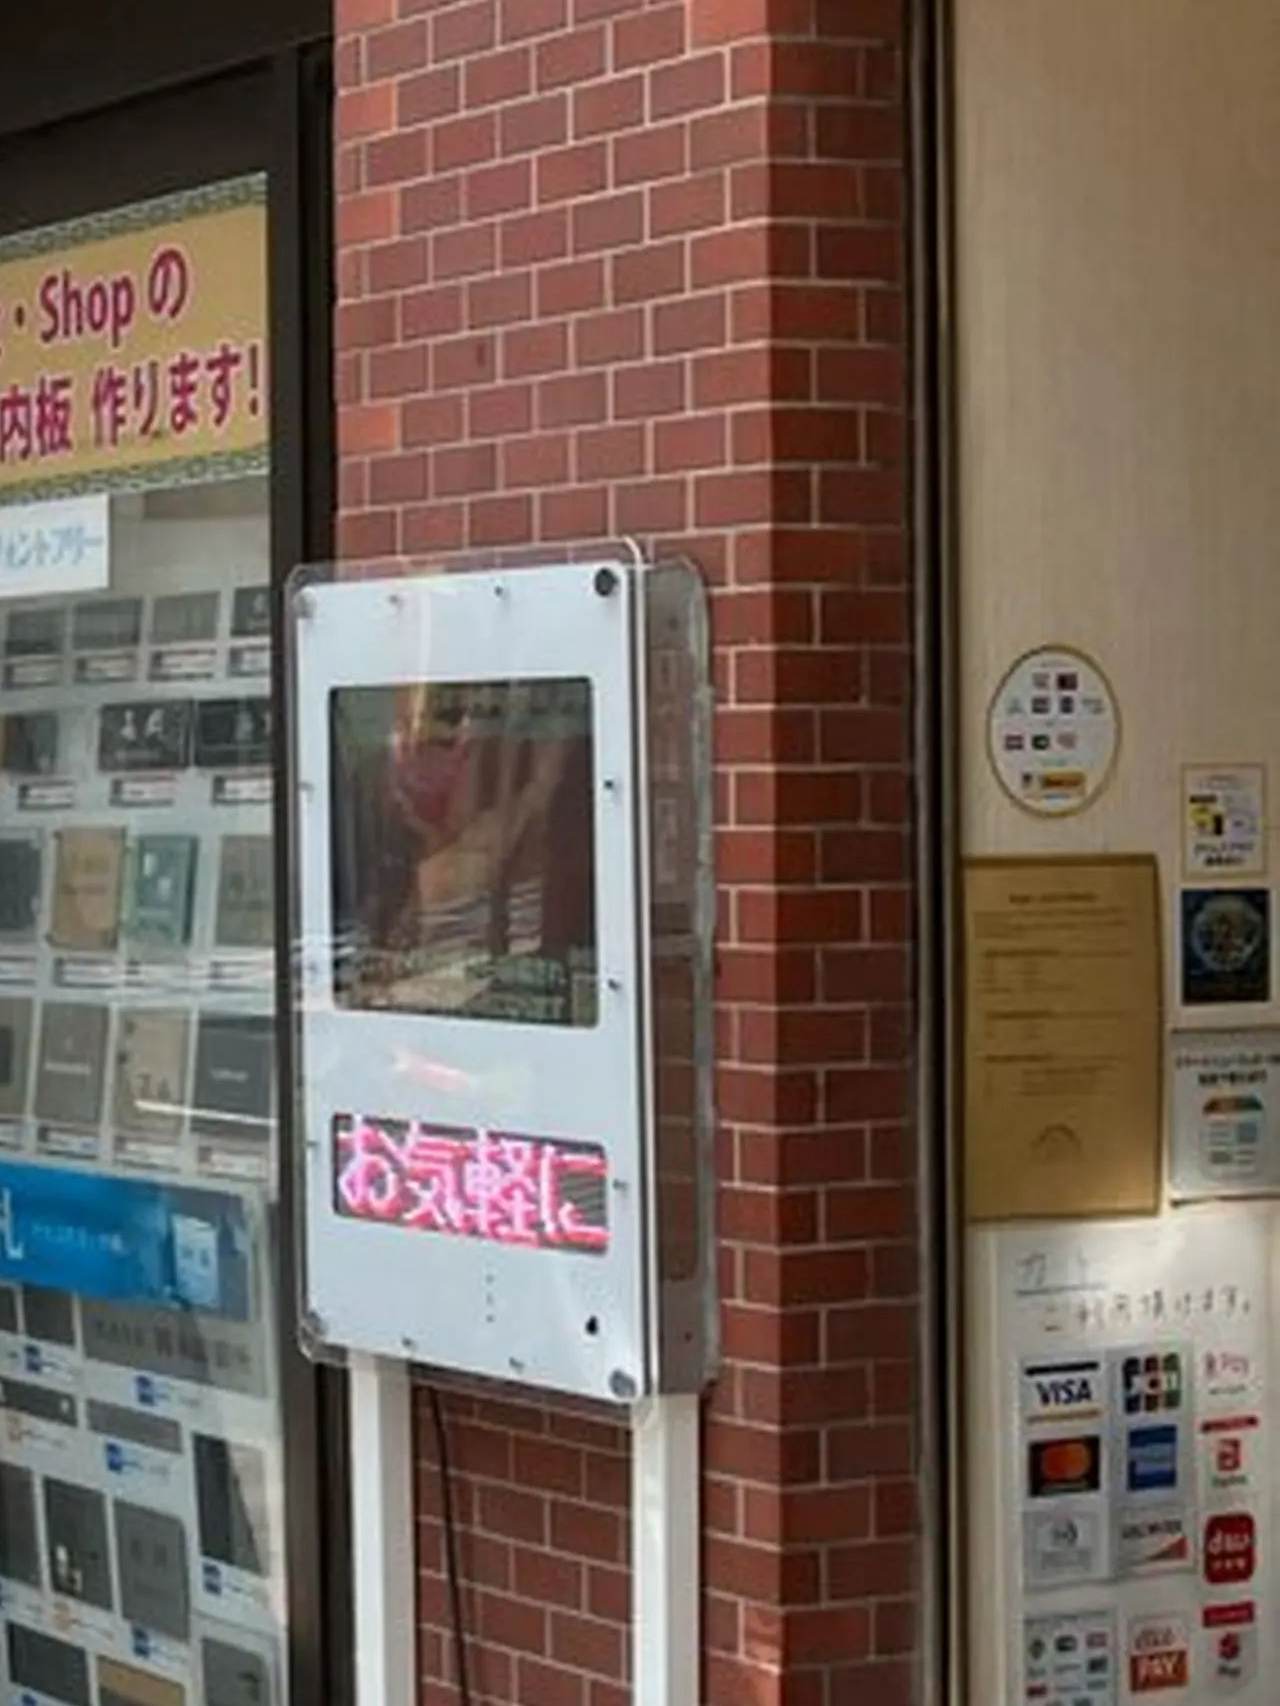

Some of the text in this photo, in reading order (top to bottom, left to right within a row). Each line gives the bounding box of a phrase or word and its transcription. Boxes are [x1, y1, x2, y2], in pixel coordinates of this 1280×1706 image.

[148, 247, 189, 320] の
[335, 1114, 610, 1248] お気軽に
[1035, 1377, 1092, 1406] VISA
